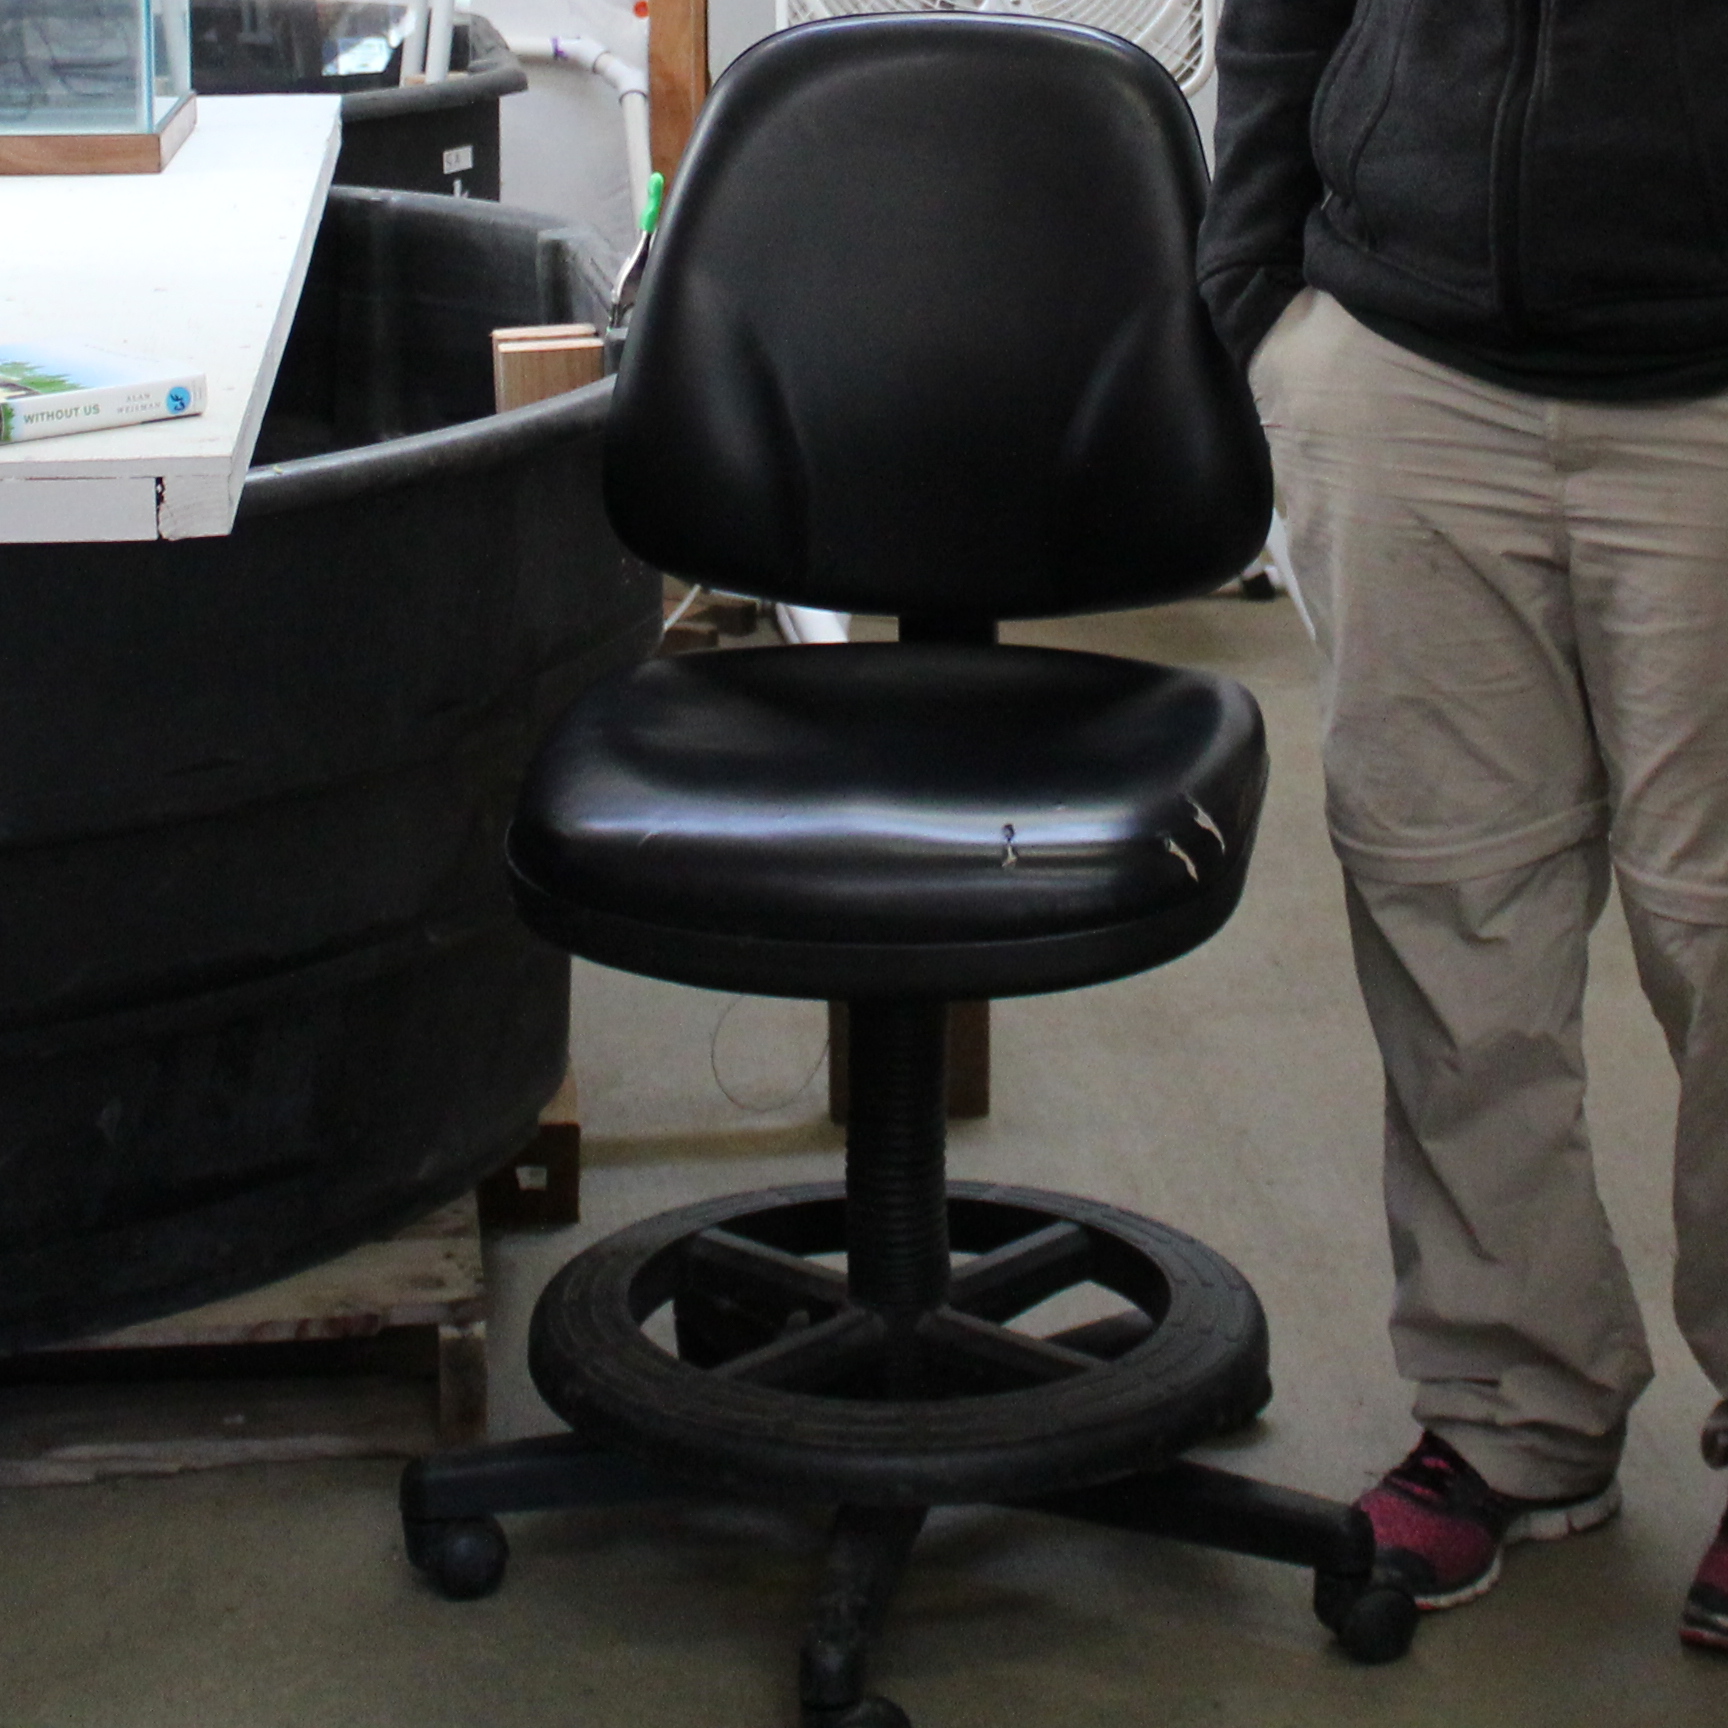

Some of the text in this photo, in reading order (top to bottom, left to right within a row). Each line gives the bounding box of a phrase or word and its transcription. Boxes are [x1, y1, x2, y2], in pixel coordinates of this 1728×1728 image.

[127, 393, 151, 403] ALAN
[24, 406, 80, 425] WITHOUT
[83, 403, 101, 417] US
[117, 402, 161, 414] WEISMAN
